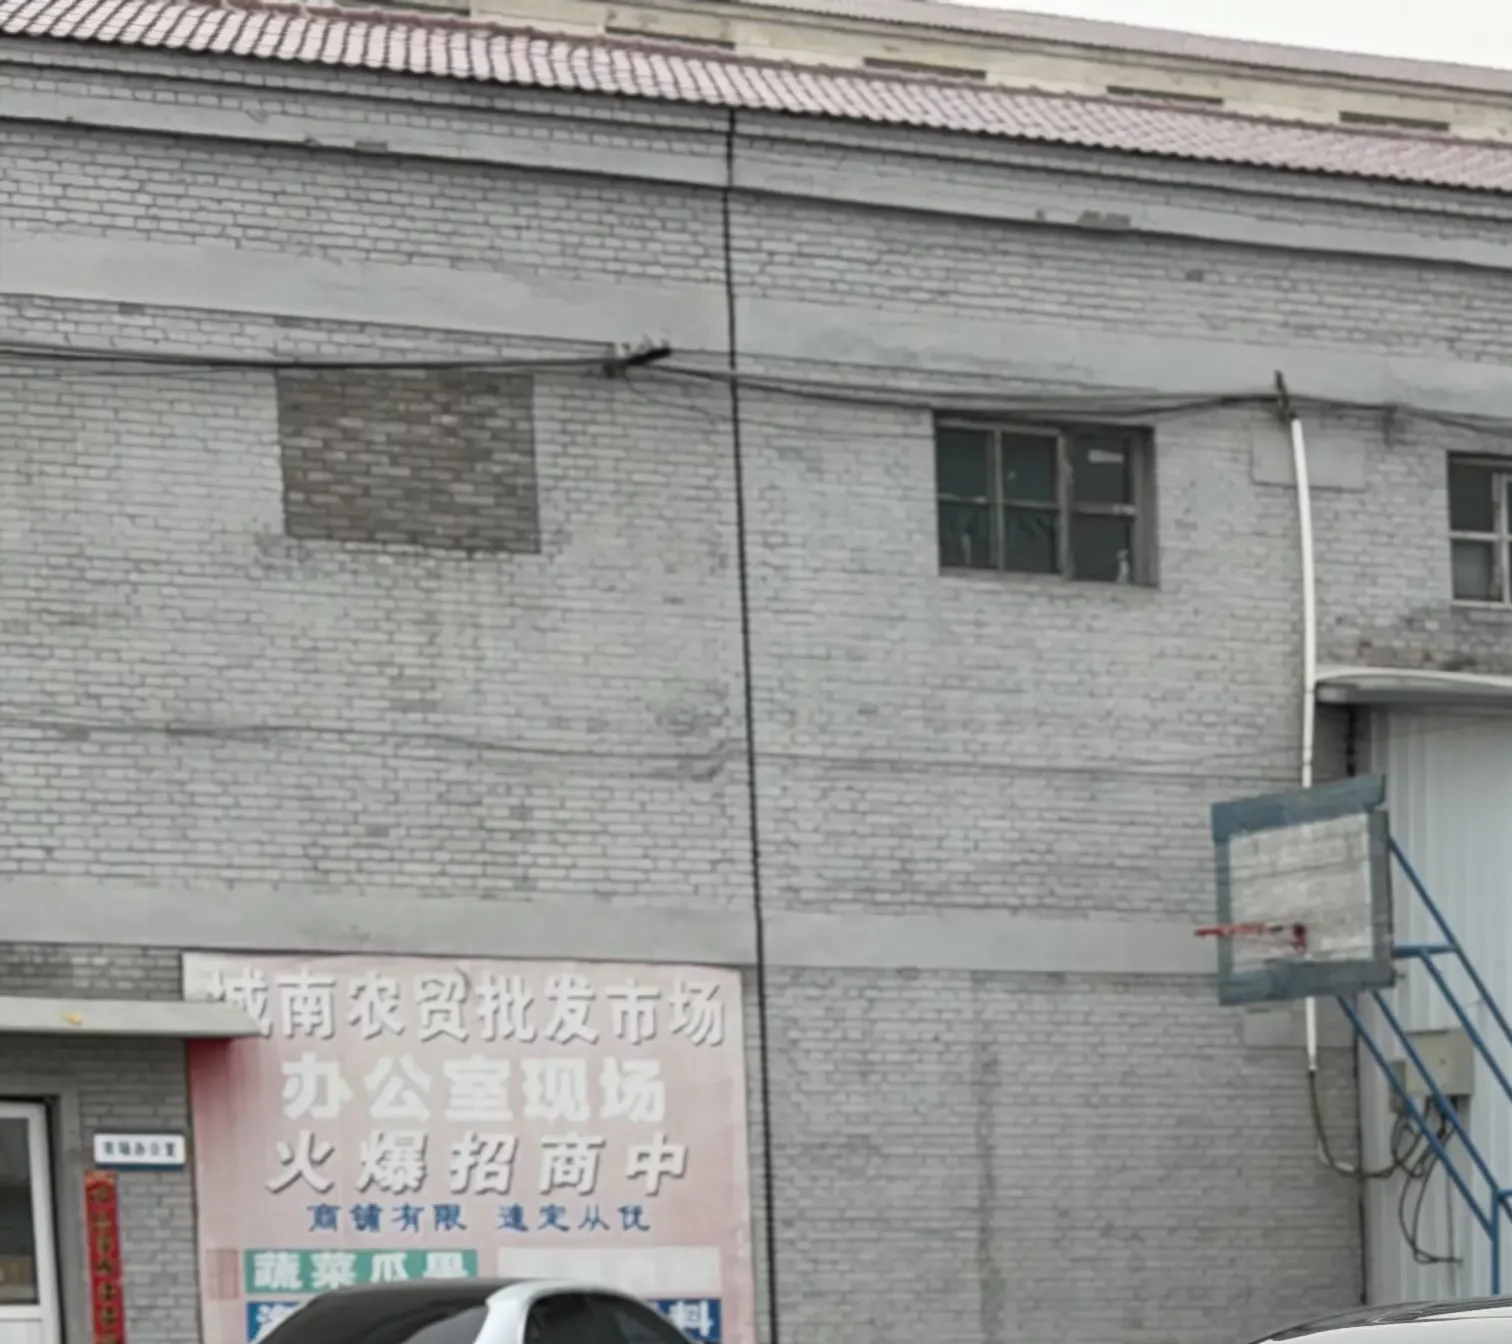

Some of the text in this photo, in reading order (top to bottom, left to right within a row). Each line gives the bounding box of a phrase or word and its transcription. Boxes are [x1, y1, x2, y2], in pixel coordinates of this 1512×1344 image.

[281, 1053, 668, 1124] 办公室现场
[266, 1129, 690, 1197] 火爆招商中
